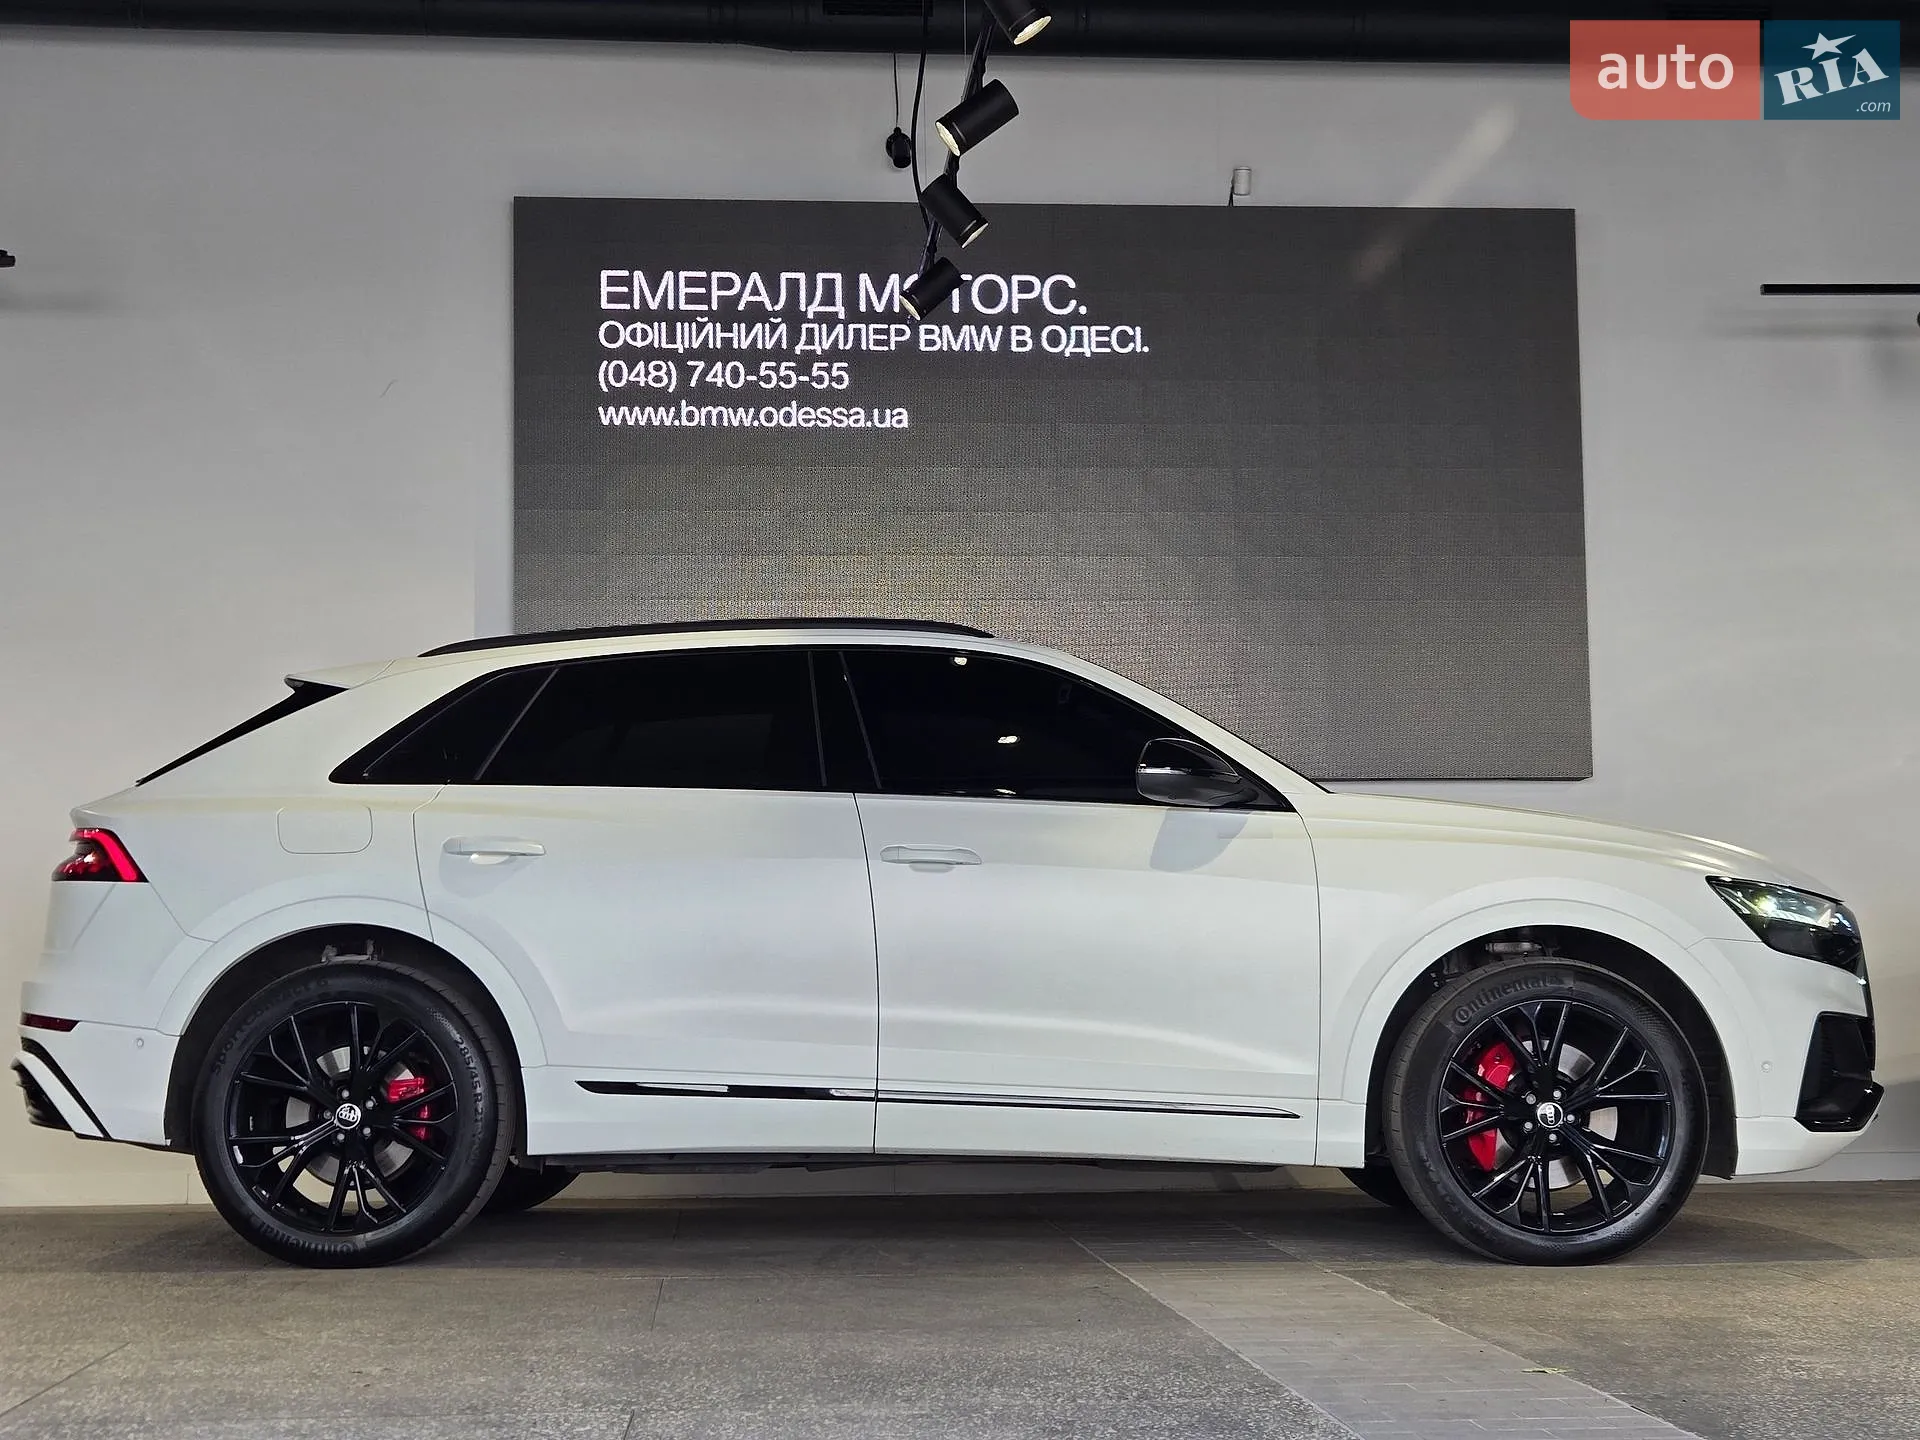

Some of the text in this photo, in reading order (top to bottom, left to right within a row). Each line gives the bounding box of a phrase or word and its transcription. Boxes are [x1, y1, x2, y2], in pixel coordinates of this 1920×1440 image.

[600, 269, 1087, 320] ЕМЕРАЛД МТОРС.
[598, 316, 788, 354] ОФІЦІЙНИЙ
[794, 322, 912, 356] ДИЛЕР
[918, 324, 1004, 352] BMW
[1040, 324, 1150, 358] ОДЕСІ.
[598, 359, 850, 393] (048) 740-55-55
[597, 399, 909, 429] www.bmw.odessa.ua
